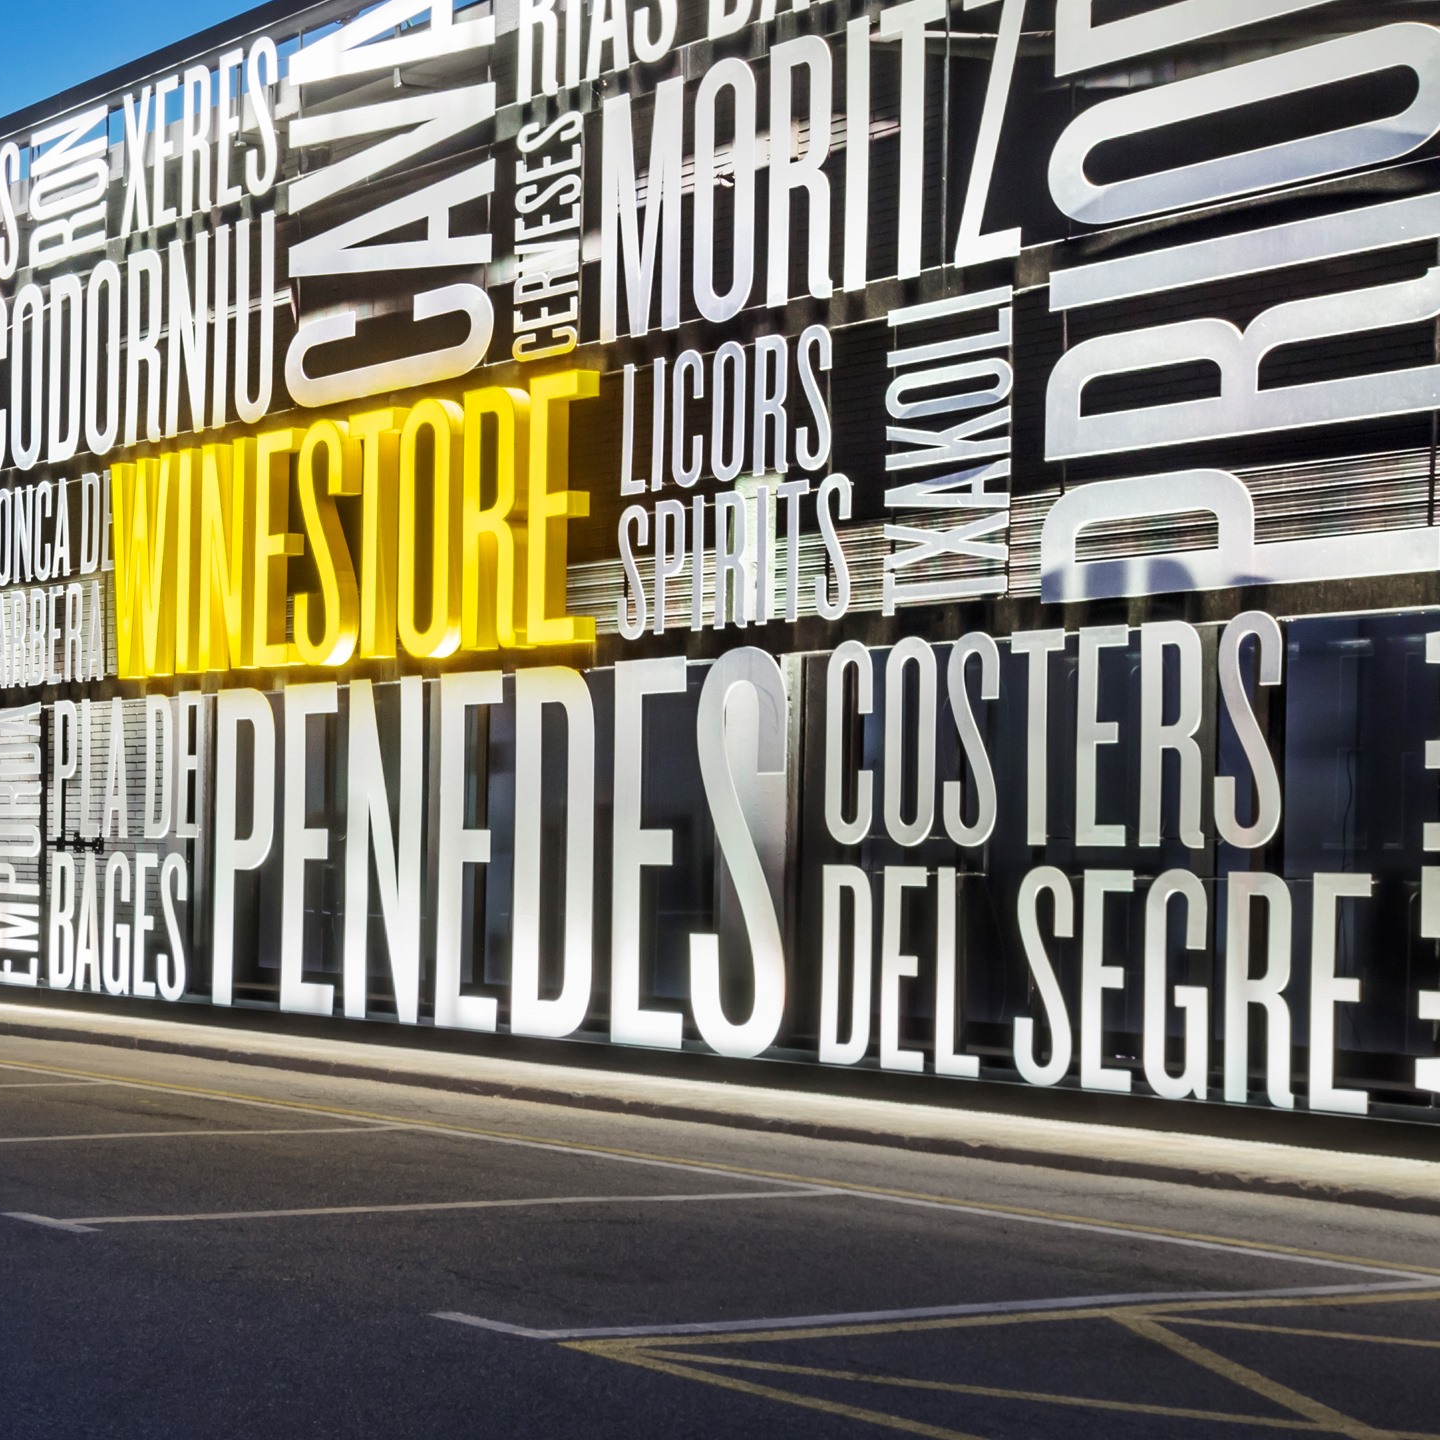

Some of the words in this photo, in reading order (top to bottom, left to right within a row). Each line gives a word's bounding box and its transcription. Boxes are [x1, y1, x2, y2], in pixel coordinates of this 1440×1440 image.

[29, 104, 109, 269] RON
[120, 36, 279, 240] XERES
[511, 110, 584, 363] CERVESES
[620, 324, 833, 496] LICORS
[882, 285, 1013, 617] TXAKOLI
[112, 369, 600, 680] WINESTORE
[618, 472, 853, 641] SPIRITS
[52, 695, 128, 842] PLA
[143, 690, 202, 841] DE
[825, 610, 1283, 850] COSTERS
[47, 849, 188, 1002] BAGES
[212, 645, 788, 1059] PENEDES
[818, 864, 980, 1078] DEL
[1013, 865, 1373, 1116] SEGRE
